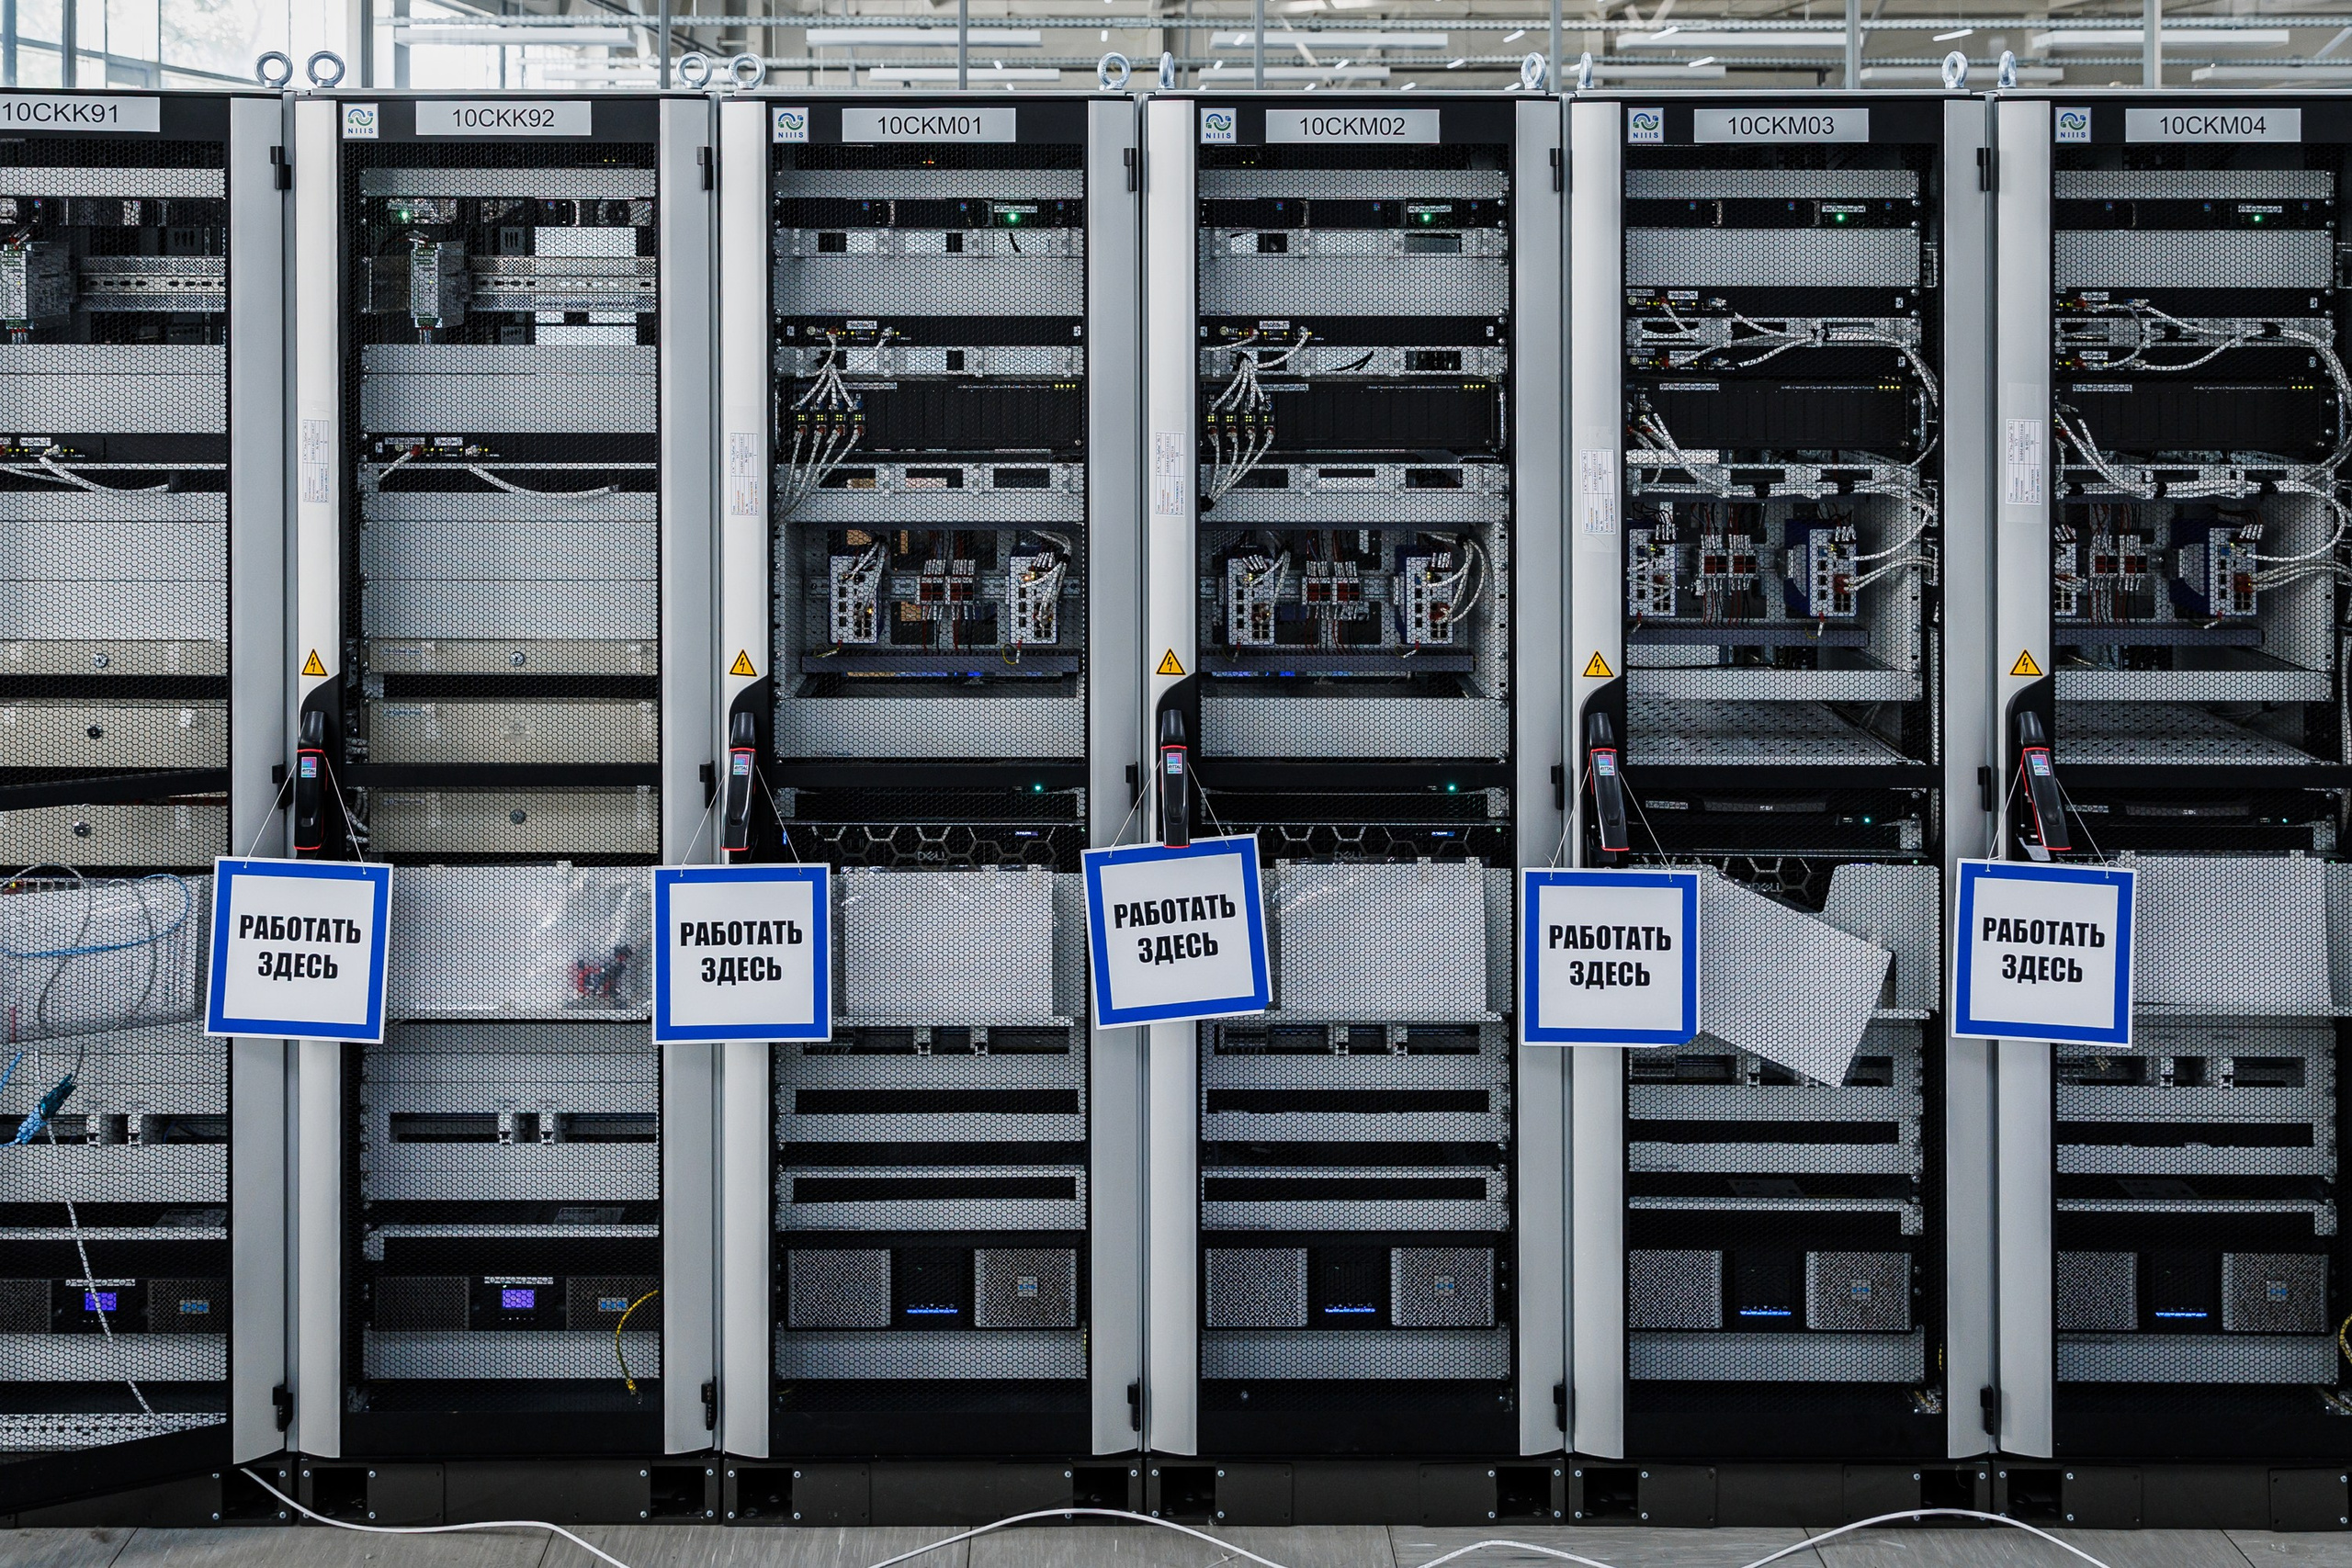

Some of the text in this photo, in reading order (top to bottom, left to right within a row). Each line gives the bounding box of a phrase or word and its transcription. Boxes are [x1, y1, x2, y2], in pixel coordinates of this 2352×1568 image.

[3, 103, 118, 122] 10CKK91
[452, 108, 555, 128] 10CKK92
[877, 116, 980, 135] 10CKM01
[1728, 116, 1835, 135] 10CKM03
[2159, 116, 2267, 135] 10CKM04
[1299, 117, 1406, 136] 10CKM02
[1114, 894, 1236, 928] РАБОТАТЬ
[240, 915, 361, 943] РАБОТАТЬ
[681, 920, 802, 946] РАБОТАТЬ
[1550, 925, 1671, 950] РАБОТАТЬ
[1984, 917, 2105, 948] РАБОТАТЬ
[1138, 931, 1218, 965] ЗДЕСЬ
[258, 952, 338, 981] ЗДЕСЬ
[702, 957, 782, 986] ЗДЕСЬ
[1570, 961, 1650, 989] ЗДЕСЬ
[2003, 953, 2083, 984] ЗДЕСЬ
